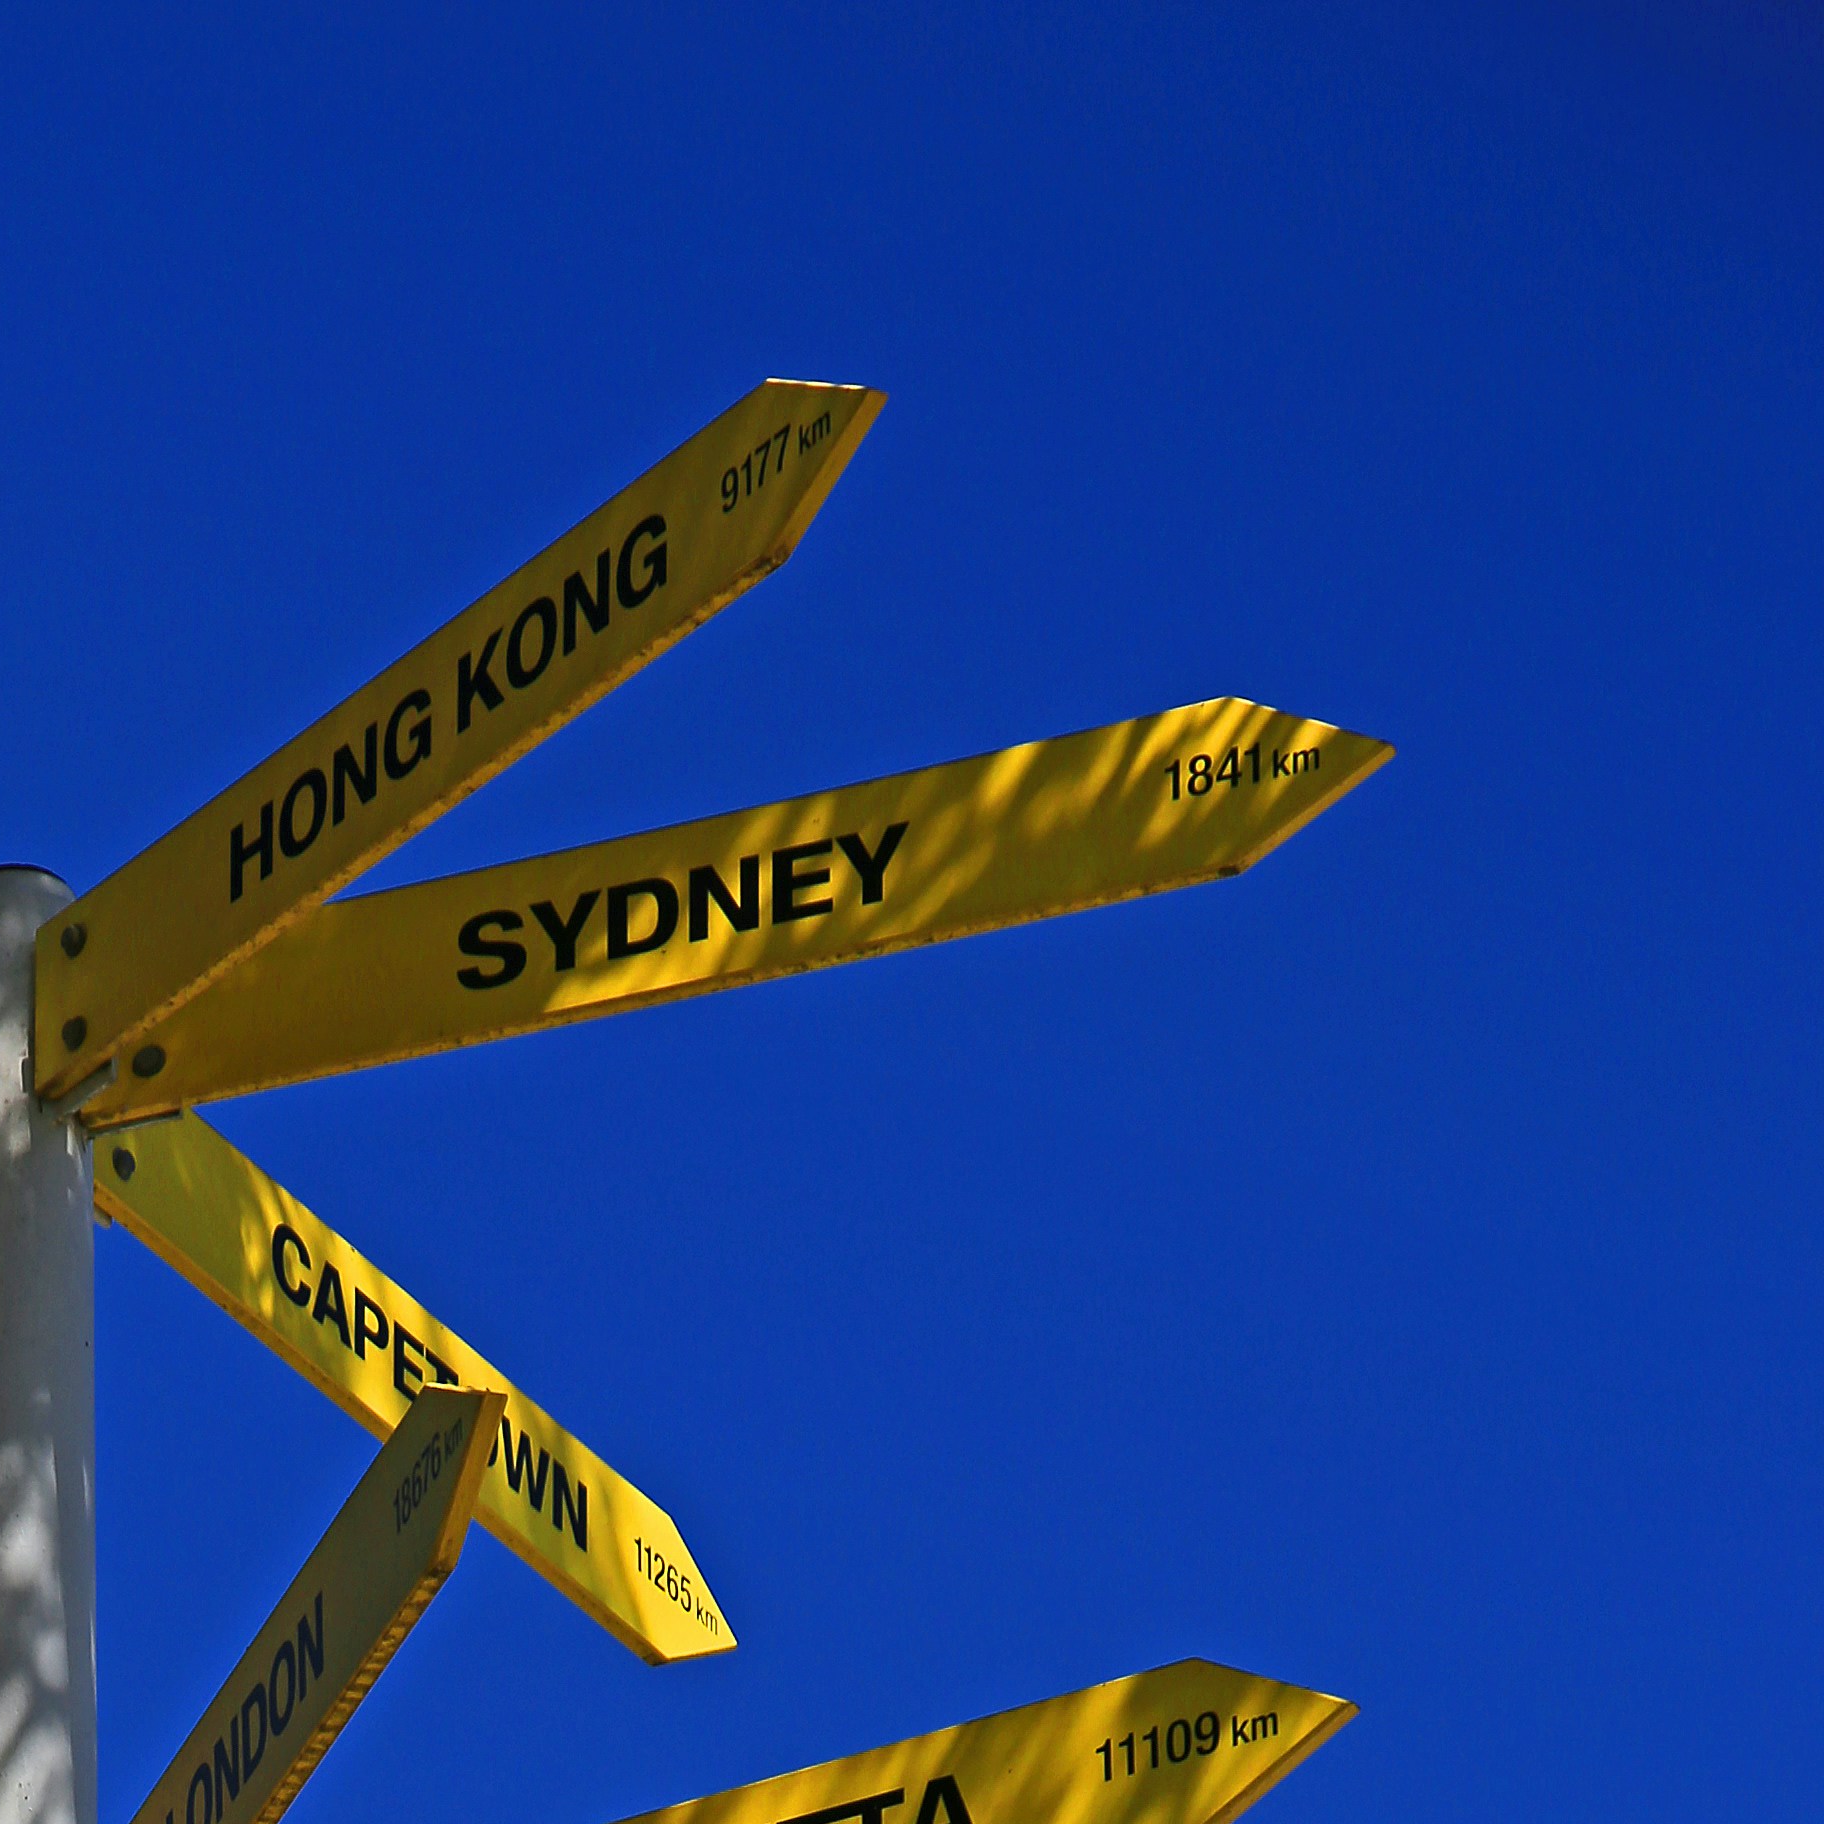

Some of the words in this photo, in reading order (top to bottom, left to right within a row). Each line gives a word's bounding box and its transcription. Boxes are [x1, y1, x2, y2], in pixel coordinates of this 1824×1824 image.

[230, 688, 433, 903] HONG
[457, 514, 667, 735] KONG
[721, 423, 790, 513] 9177
[798, 410, 831, 457] km
[456, 821, 909, 990] SYDNEY
[633, 1536, 692, 1613] 11265
[695, 1596, 718, 1635] km
[1094, 1710, 1221, 1782] 11109
[1231, 1707, 1280, 1749] km
